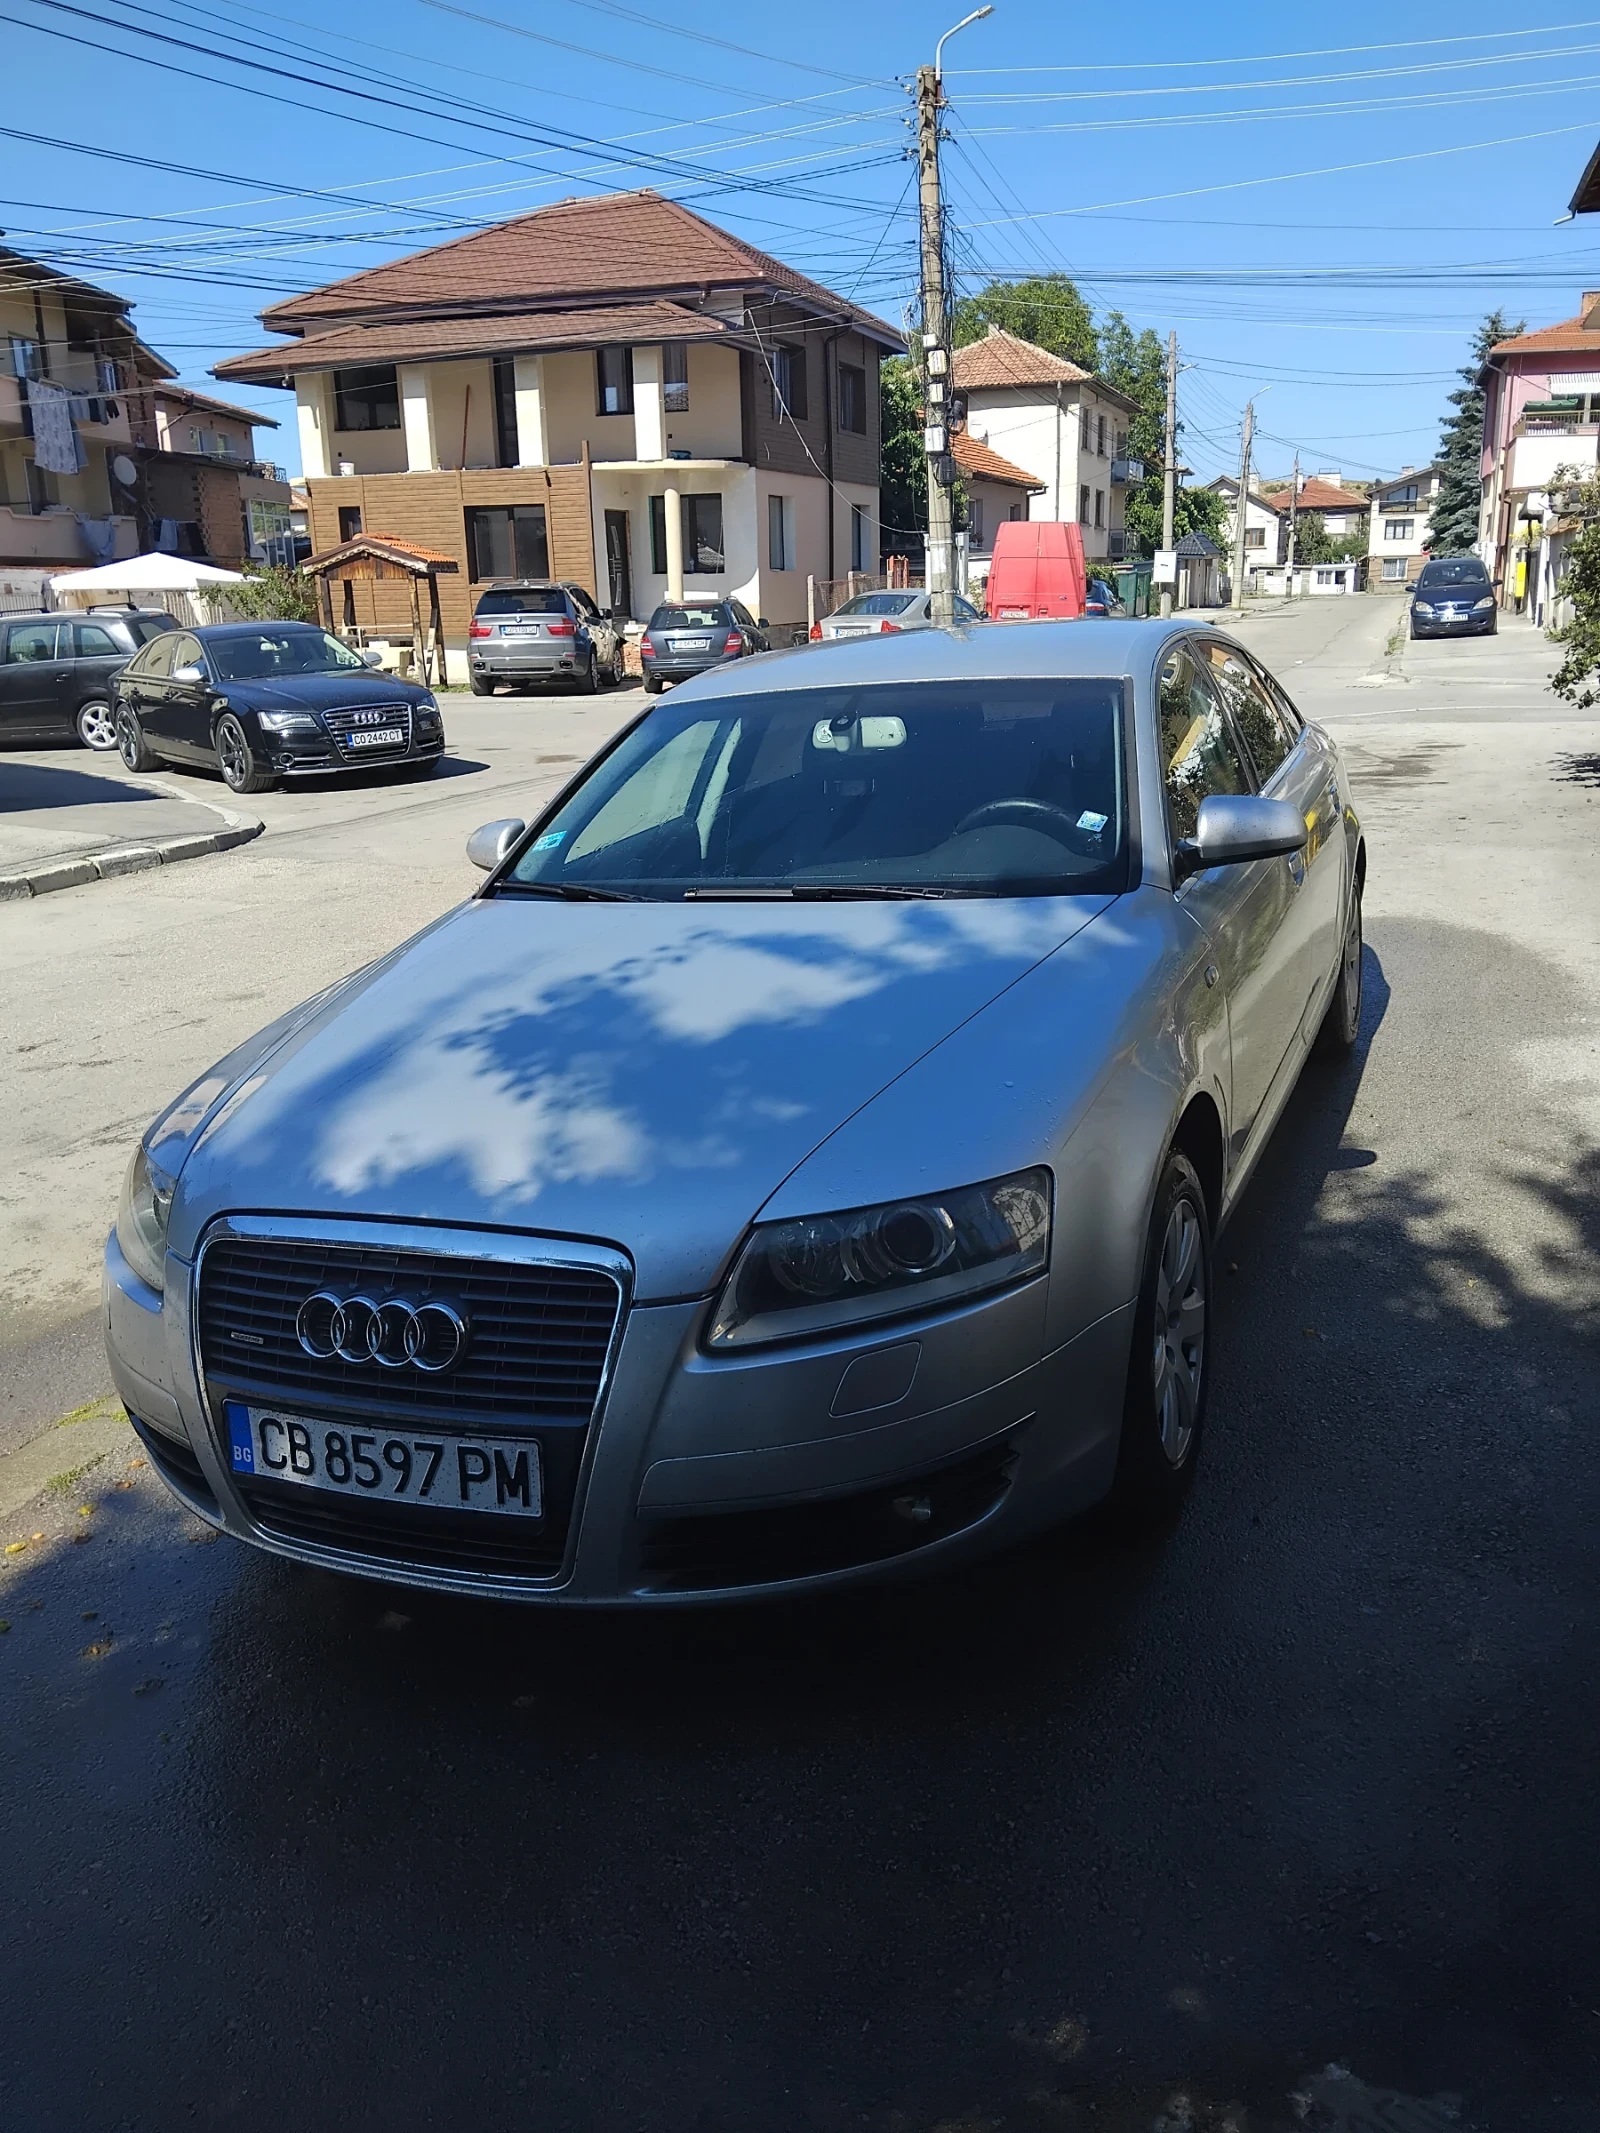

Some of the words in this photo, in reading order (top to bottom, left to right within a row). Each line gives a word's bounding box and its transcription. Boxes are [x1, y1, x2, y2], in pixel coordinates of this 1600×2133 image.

[354, 734, 366, 745] CO
[367, 731, 389, 744] 2442
[389, 730, 400, 741] CT
[233, 1444, 252, 1464] BG
[258, 1417, 316, 1477] CB
[324, 1430, 444, 1498] 8597
[456, 1444, 532, 1508] PM
